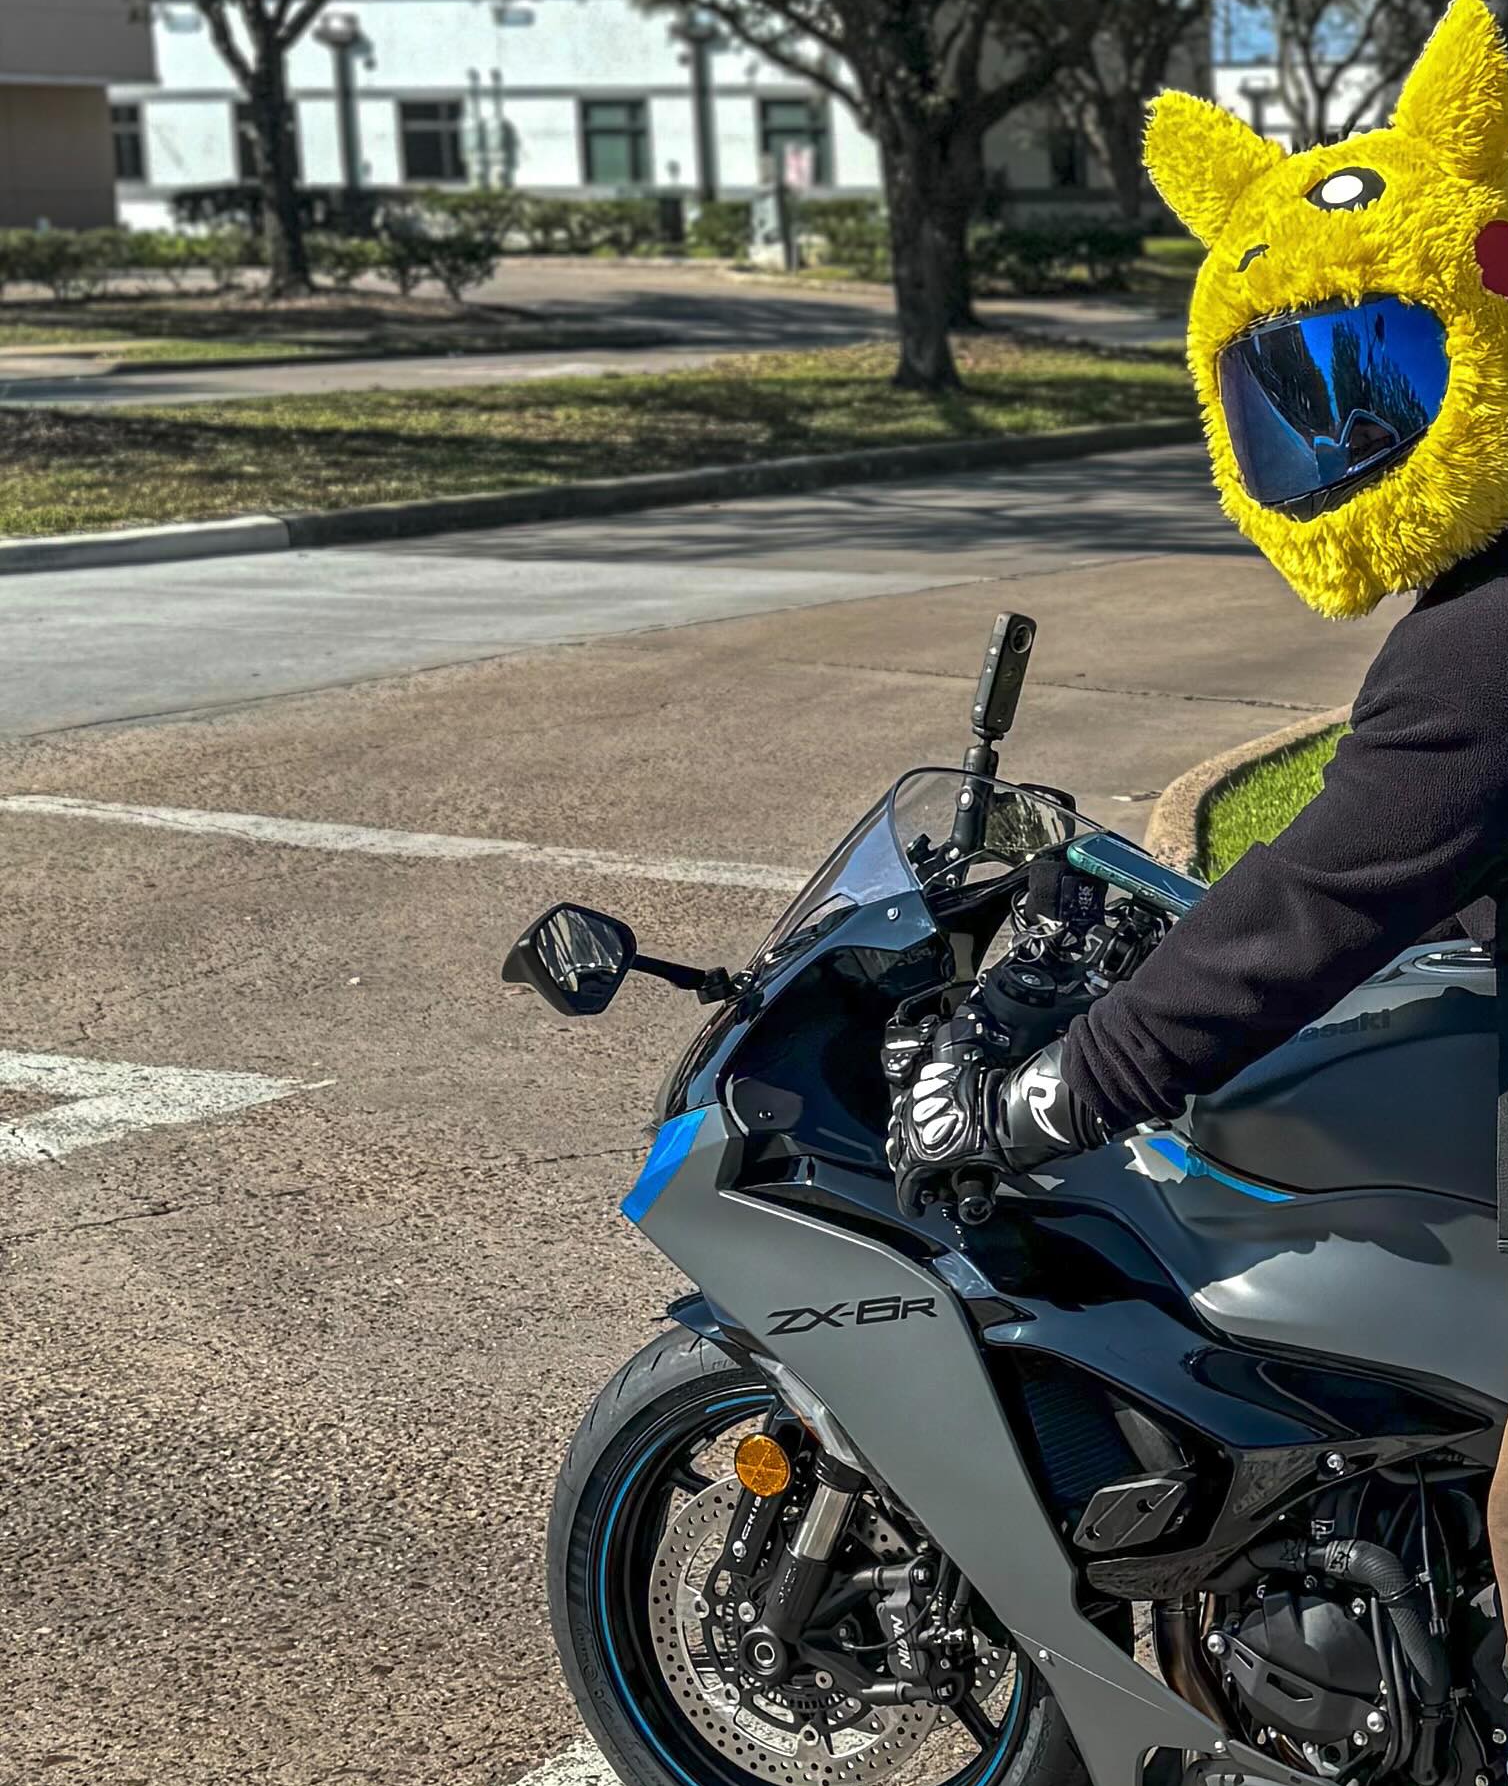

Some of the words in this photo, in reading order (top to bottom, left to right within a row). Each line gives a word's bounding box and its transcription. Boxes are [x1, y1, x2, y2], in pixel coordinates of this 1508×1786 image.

[1297, 1007, 1392, 1043] asaki
[765, 1295, 939, 1336] ZX-6R
[890, 1613, 913, 1670] NISIN
